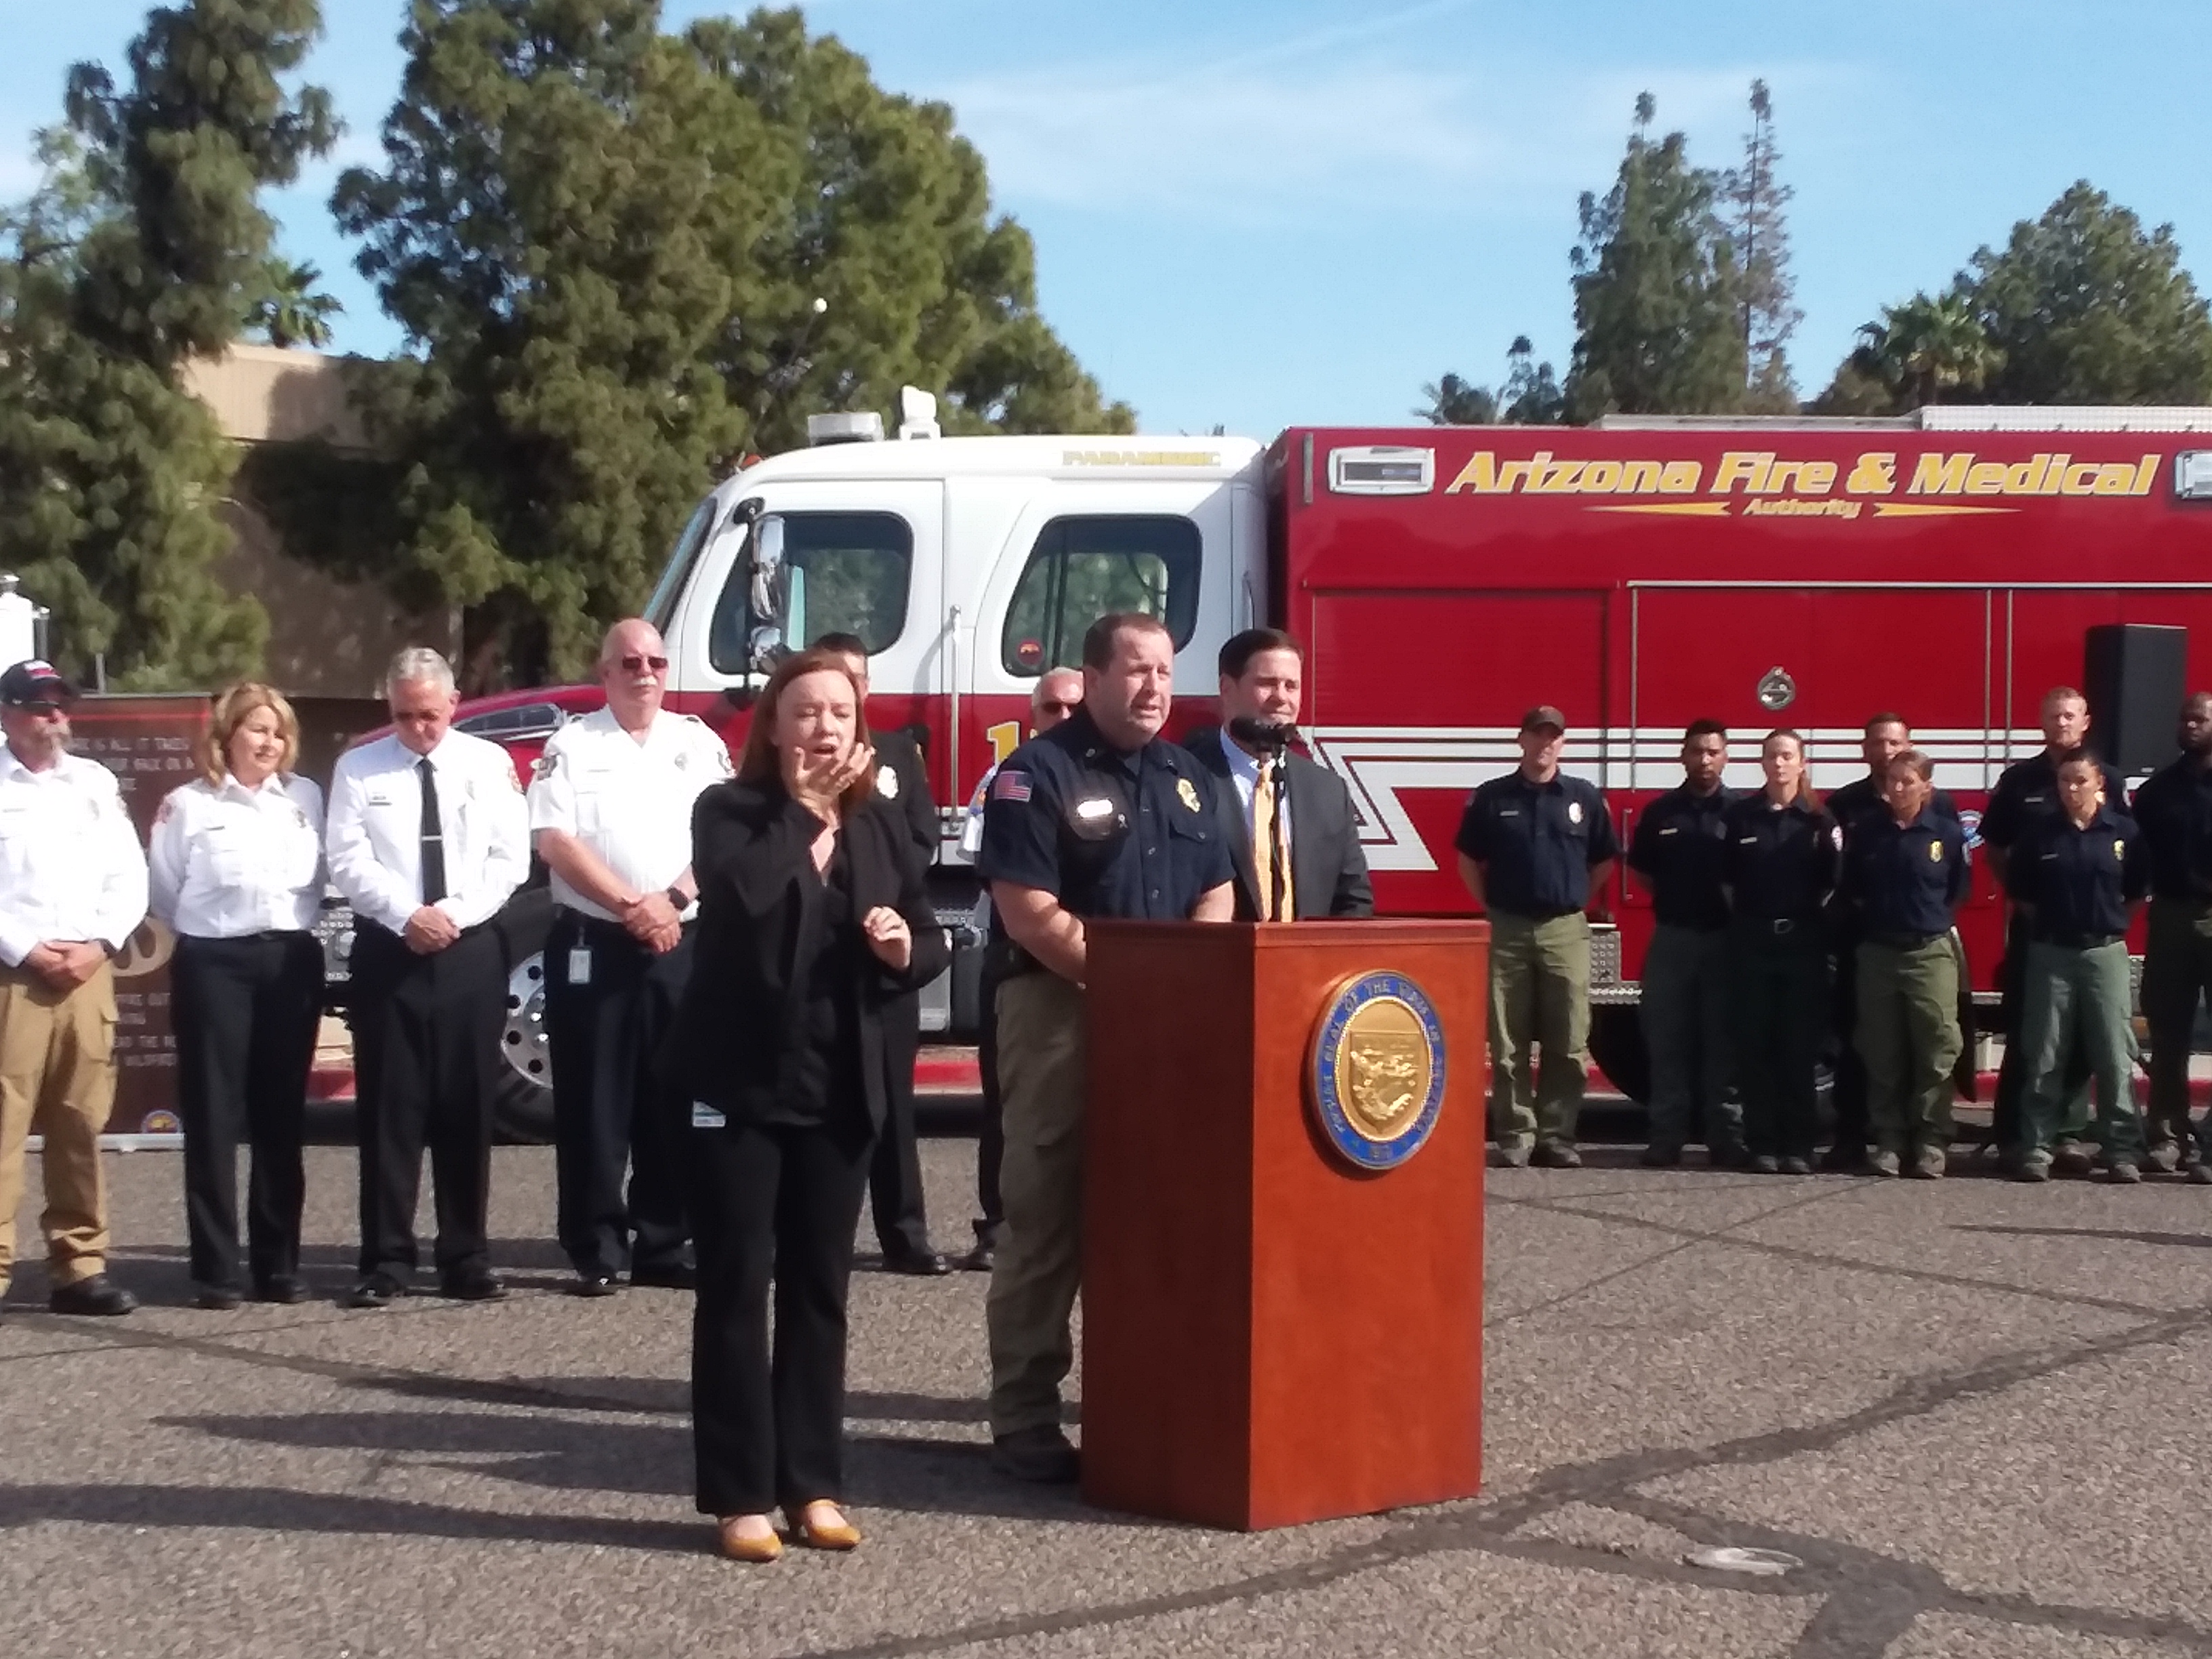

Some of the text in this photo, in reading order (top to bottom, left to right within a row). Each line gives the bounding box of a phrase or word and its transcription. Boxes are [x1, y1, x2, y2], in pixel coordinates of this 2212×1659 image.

[1443, 451, 2163, 496] Arizona Fire & Medical
[1742, 498, 1863, 519] Authority
